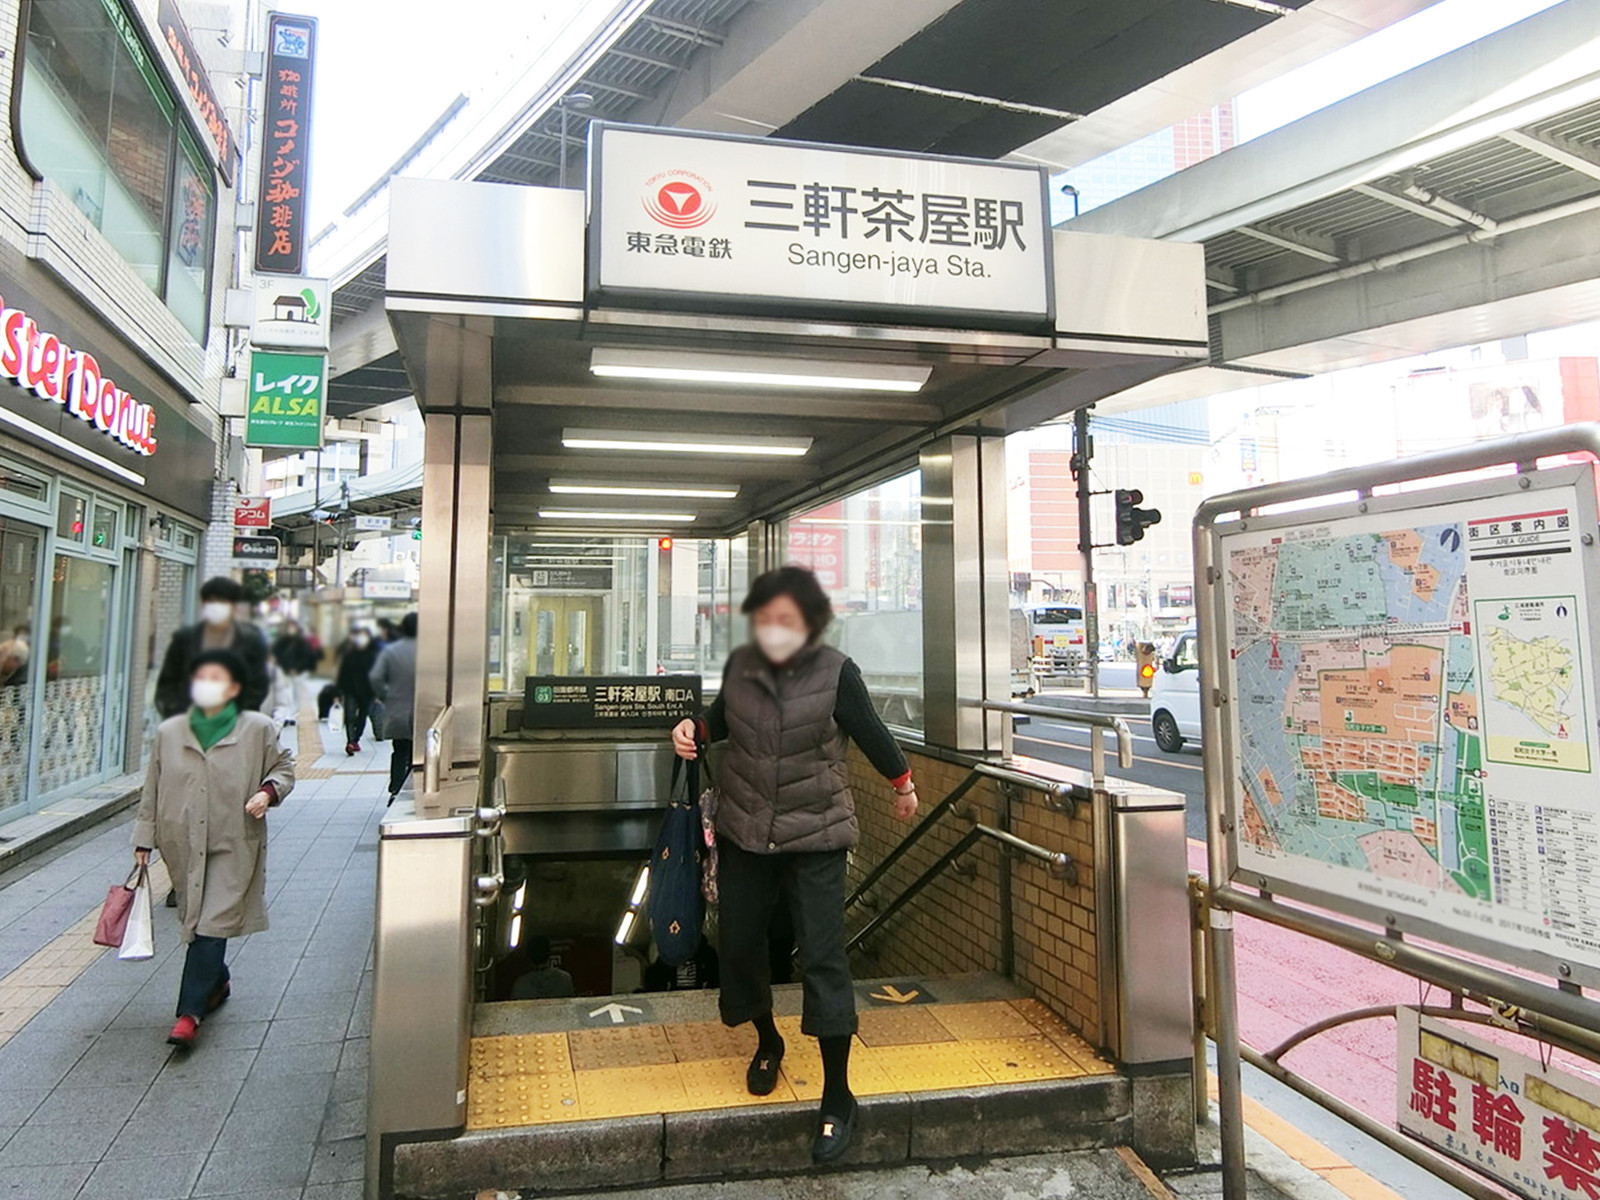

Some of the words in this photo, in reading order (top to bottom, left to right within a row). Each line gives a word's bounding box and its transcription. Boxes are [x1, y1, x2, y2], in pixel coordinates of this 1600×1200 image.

[266, 118, 301, 256] コメダ珈琲店
[744, 180, 1027, 252] 三軒茶屋駅
[626, 231, 732, 260] 東急電鉄
[788, 243, 939, 279] Sangen-jaya
[946, 255, 993, 279] Sta.
[259, 280, 274, 290] 3F
[0, 295, 77, 404] ster
[70, 351, 158, 456] Donut
[255, 372, 319, 396] レイク
[251, 396, 318, 416] ALSA
[237, 509, 265, 519] アコム
[1468, 516, 1570, 538] 街区案内図
[789, 532, 836, 546] ラオケ
[1496, 536, 1515, 546] AREA
[1518, 534, 1540, 544] GUIDE
[595, 686, 661, 702] 三軒茶屋駅
[665, 689, 695, 702] 南口A
[594, 703, 633, 712] Sangen-jaya
[647, 703, 665, 711] South
[1498, 1075, 1520, 1095] 入口
[1409, 1057, 1600, 1200] 駐輪禁
